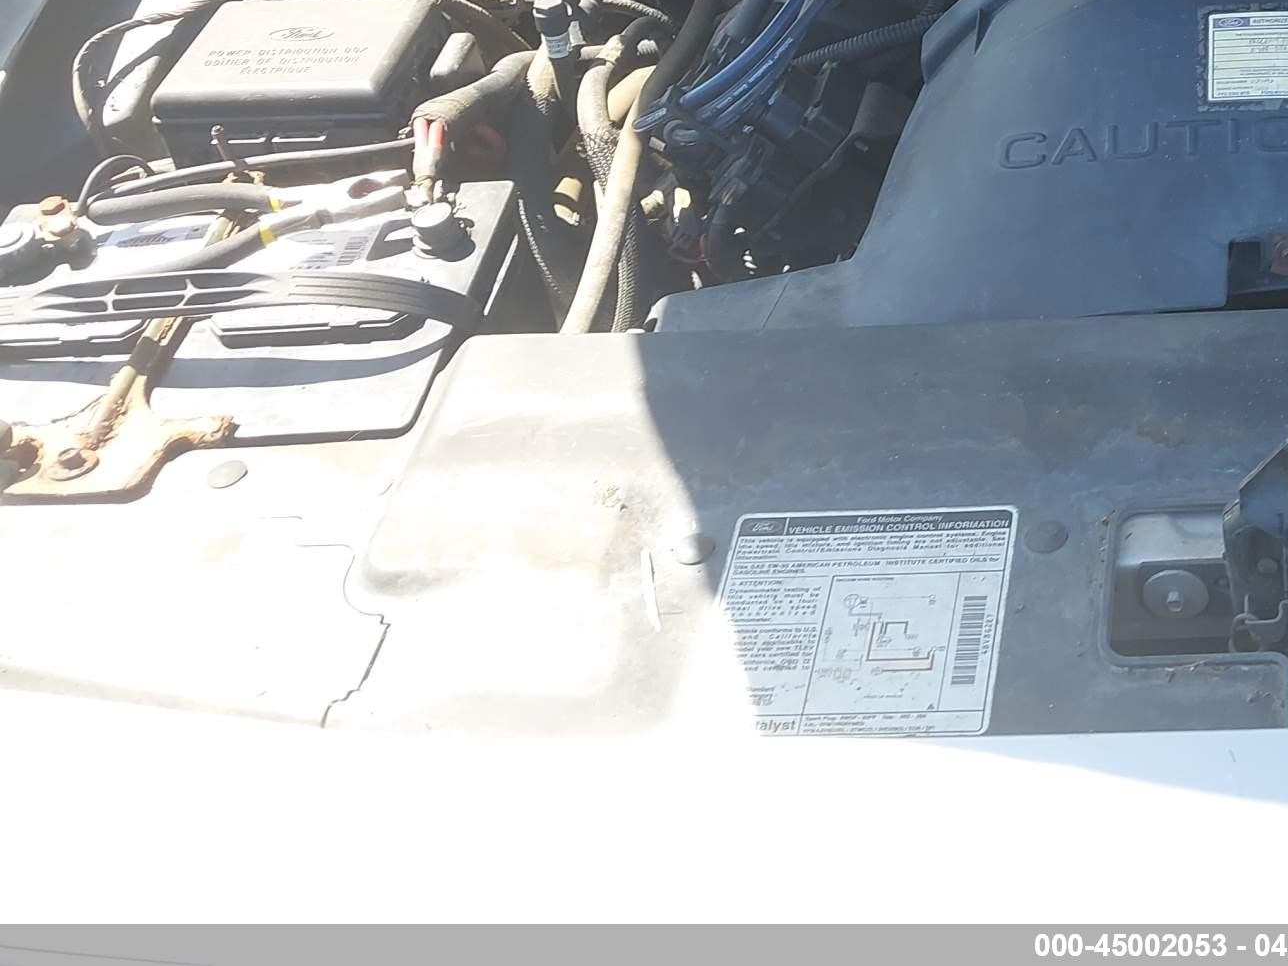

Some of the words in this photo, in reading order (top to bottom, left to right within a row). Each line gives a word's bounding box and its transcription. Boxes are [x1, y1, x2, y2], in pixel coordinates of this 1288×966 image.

[903, 514, 944, 522] Company
[787, 525, 832, 533] VEHICLE
[834, 523, 884, 532] EMISSION
[885, 522, 936, 530] CONTROL
[936, 520, 1009, 529] INFORMATION
